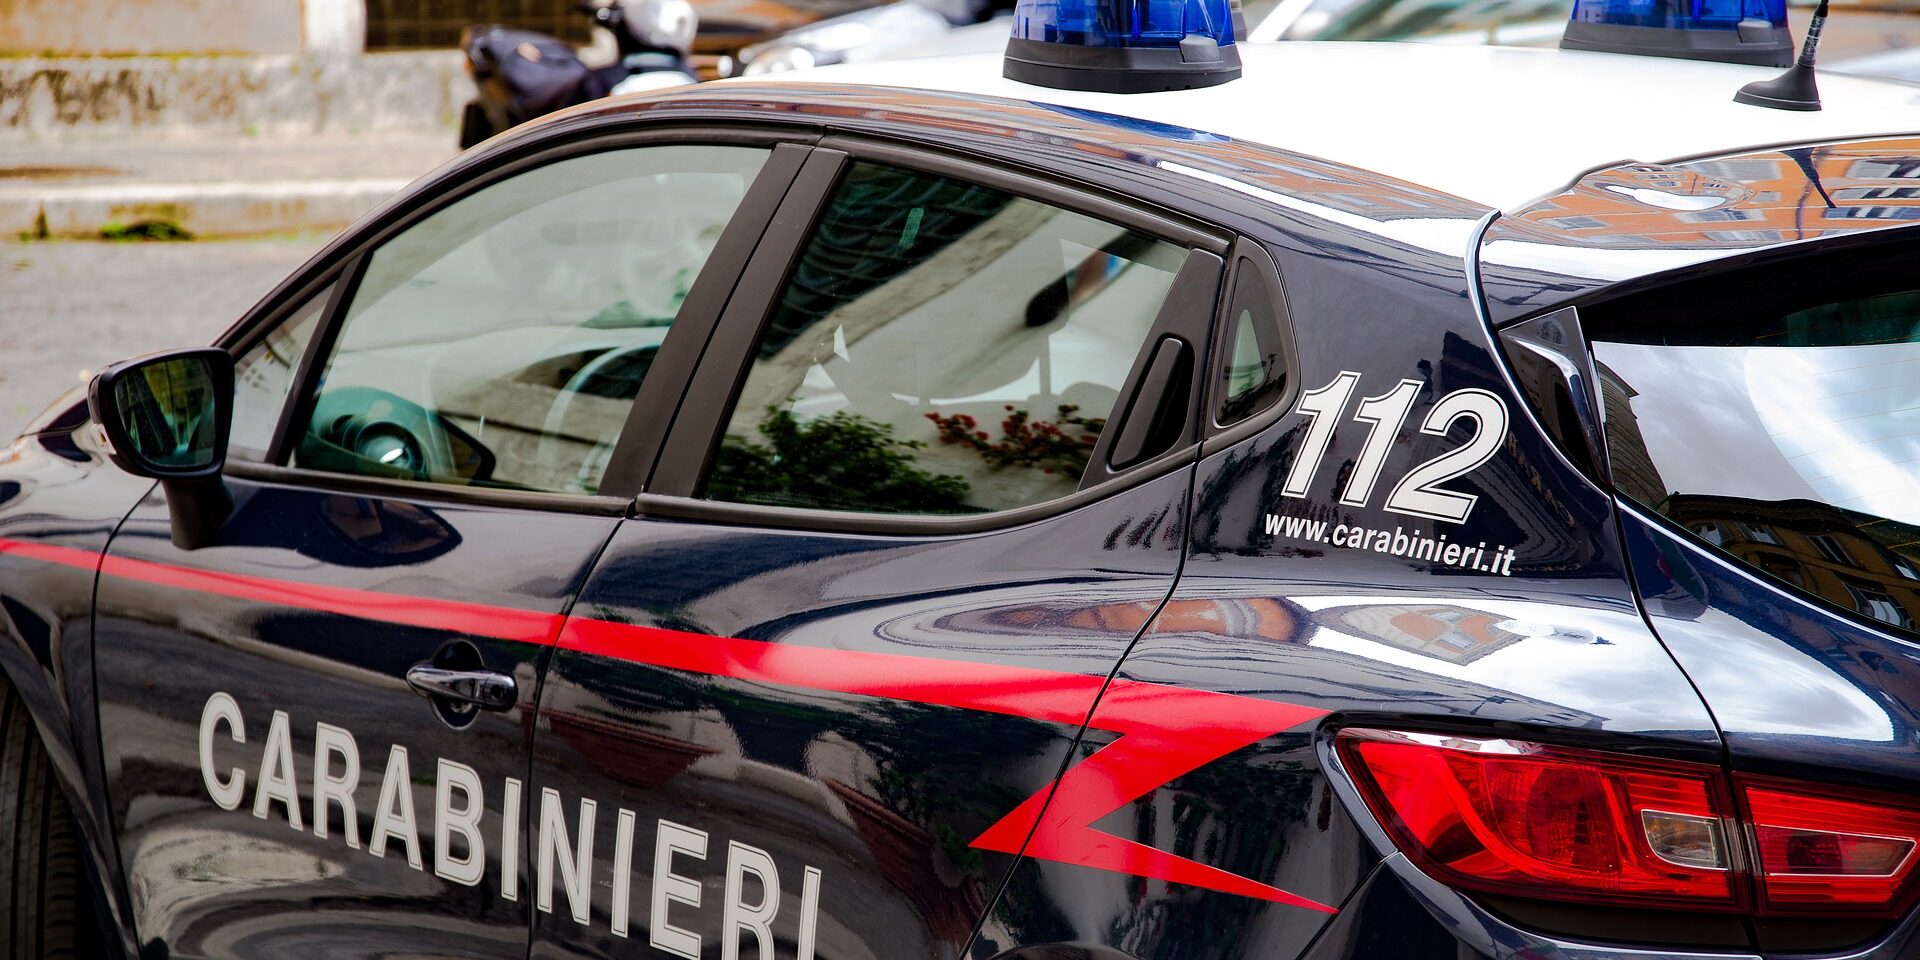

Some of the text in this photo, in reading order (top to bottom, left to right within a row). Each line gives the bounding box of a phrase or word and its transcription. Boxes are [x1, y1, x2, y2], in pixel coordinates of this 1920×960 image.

[1281, 370, 1509, 525] 112
[1265, 513, 1516, 577] www.carabinieri.it
[198, 691, 822, 960] CARABINIERI
